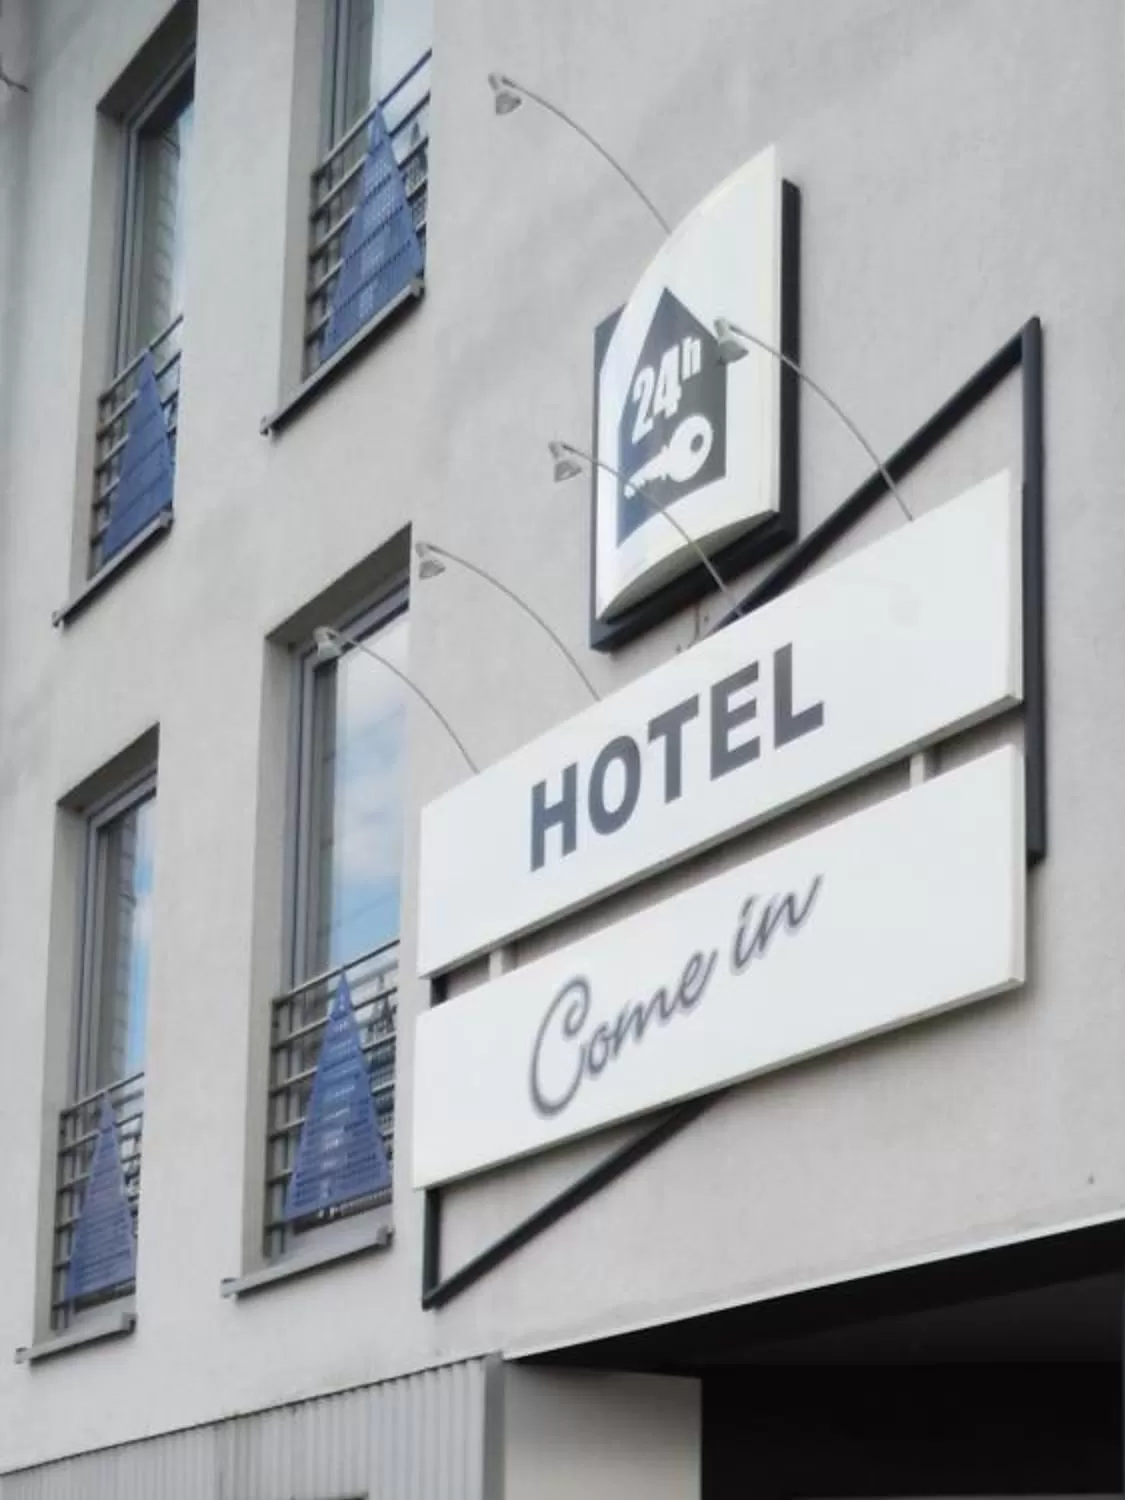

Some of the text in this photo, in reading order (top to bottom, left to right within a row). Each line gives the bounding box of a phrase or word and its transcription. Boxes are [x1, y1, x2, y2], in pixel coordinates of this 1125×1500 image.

[530, 642, 825, 873] HOTEL
[528, 873, 825, 1119] Come in
